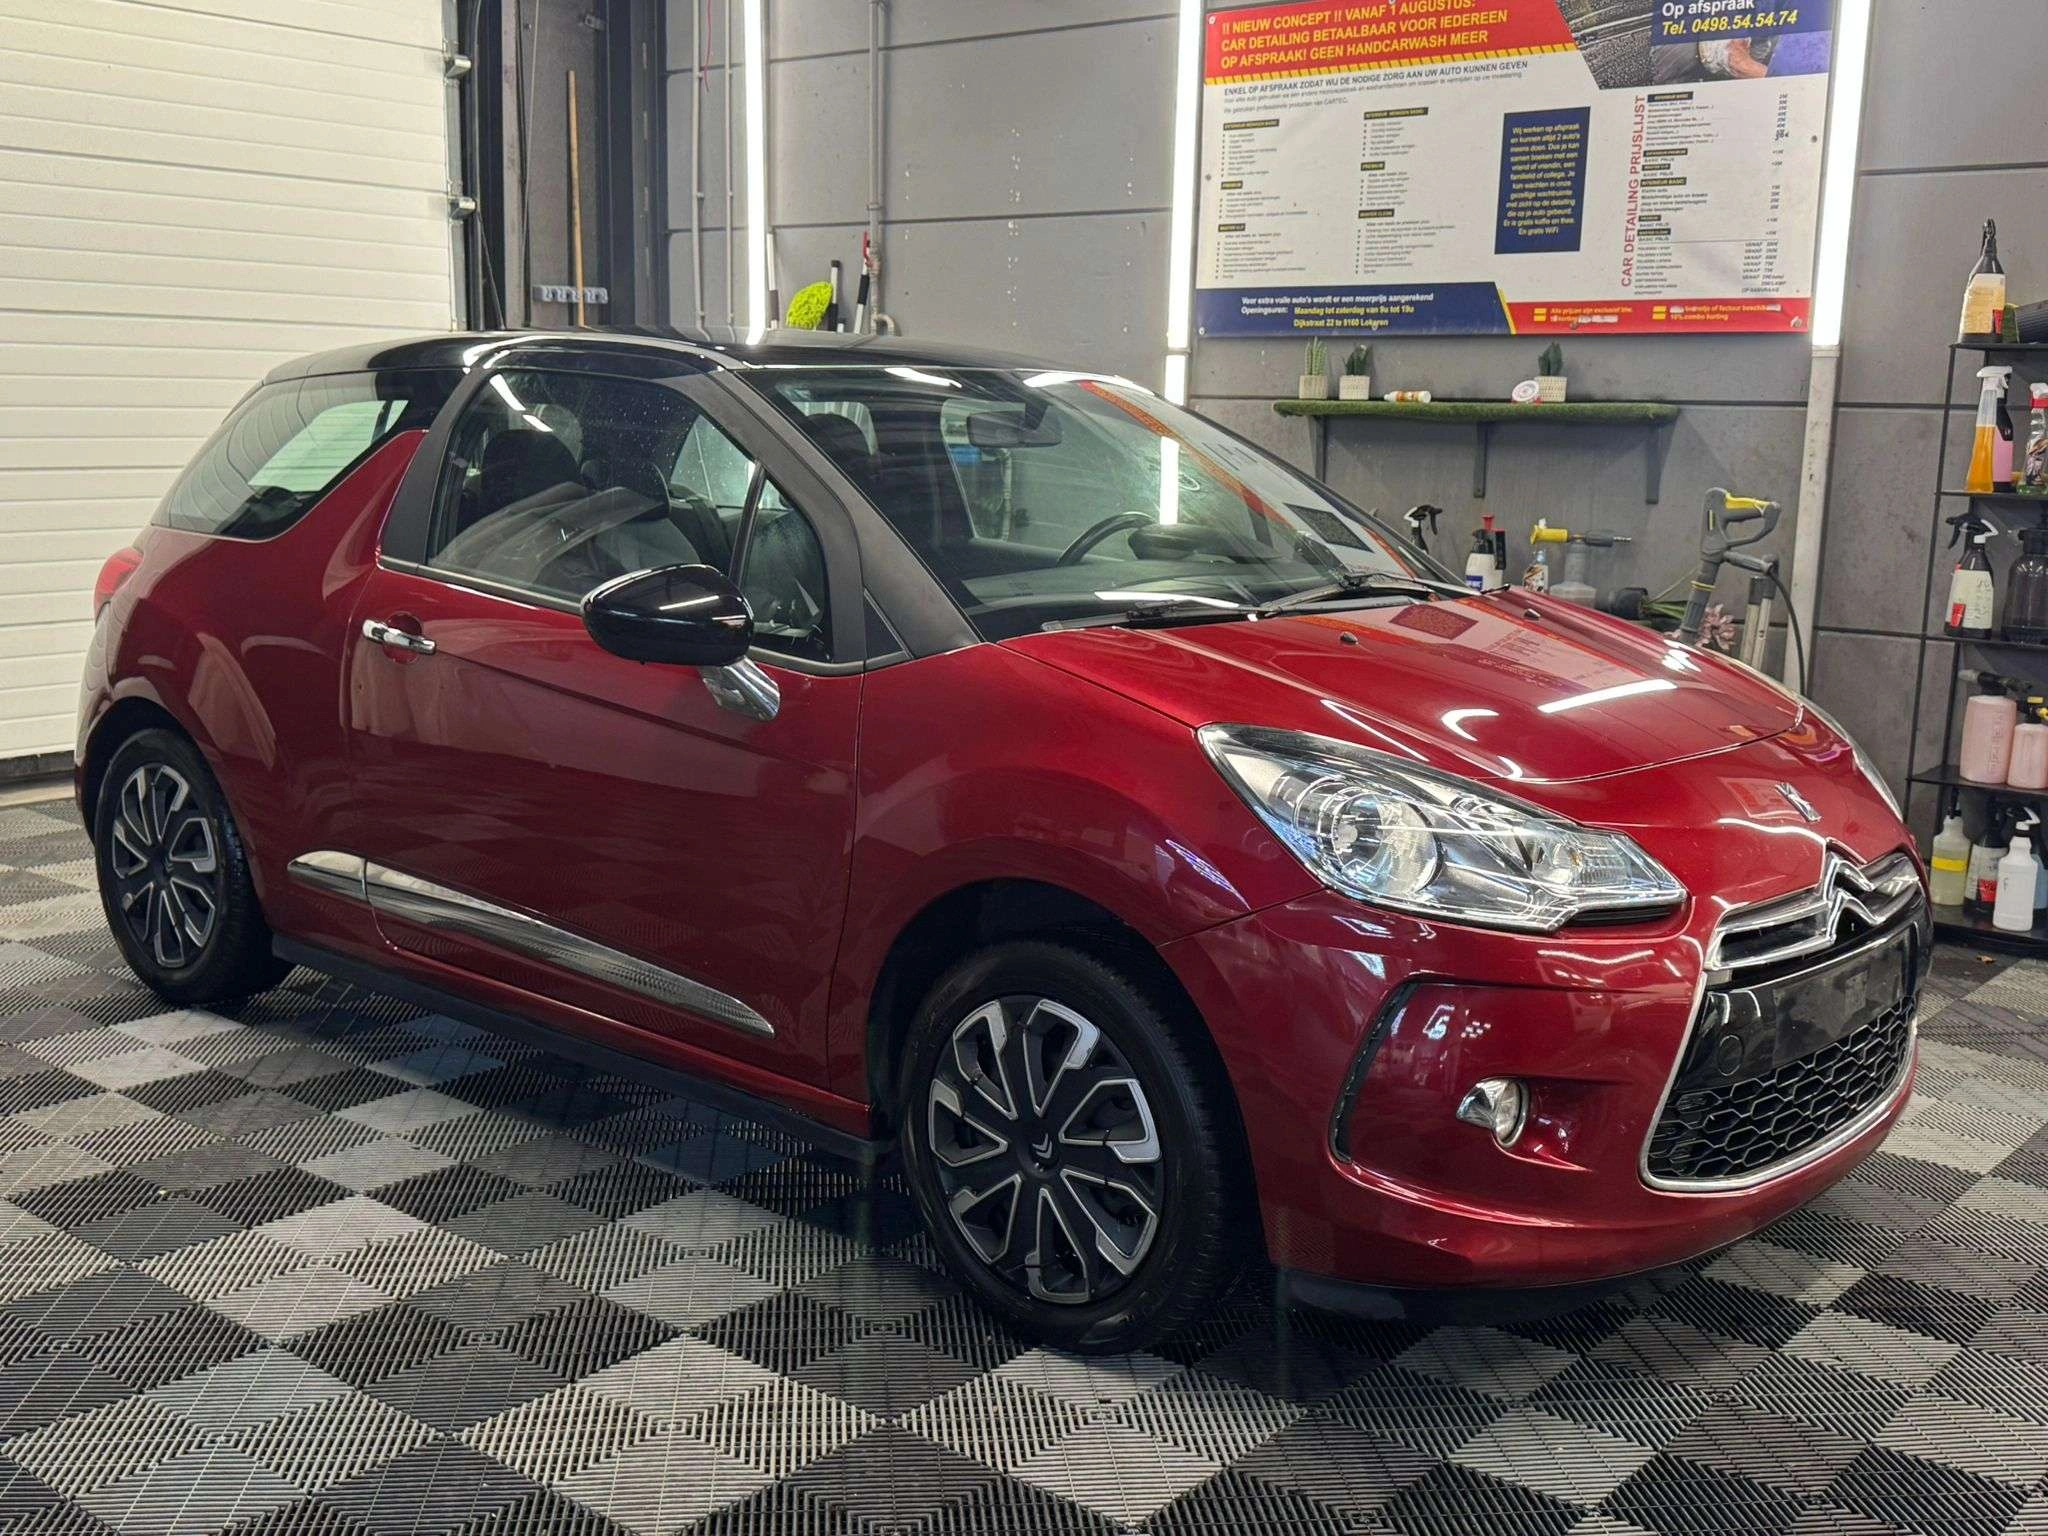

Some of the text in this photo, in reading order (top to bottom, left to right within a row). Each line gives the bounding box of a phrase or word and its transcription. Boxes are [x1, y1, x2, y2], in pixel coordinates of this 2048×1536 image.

[1232, 17, 1271, 34] NIEUW
[1273, 11, 1332, 29] CONCEPT
[1345, 4, 1387, 20] VANAF
[1662, 0, 1755, 18] Op afspraak
[1662, 9, 1798, 36] Tel. 0498.54.54.74
[1221, 9, 1508, 51] CAR DETAILING BETAALBAAR VOOR IEDEREEN
[1221, 30, 1489, 69] OP AFSPRAAK! GEEN HANDCARWASH MEER
[1224, 60, 1528, 96] ENKEL OP AFSPRAAK ZODAT WIJ DE NODIGE ZORG AAN UW AUTO KUNNEN GEVEN
[1554, 124, 1580, 132] afspraak
[1621, 95, 1646, 287] CAR DETAILING PRIJSLIJST
[1241, 306, 1288, 315] Openingsuren:
[1294, 307, 1325, 316] Maandag
[1335, 306, 1365, 315] zaterdag
[1291, 295, 1312, 303] auto's
[1313, 295, 1332, 303] wordt
[1355, 294, 1387, 303] meerprijs
[1388, 293, 1433, 303] aangerekend
[1293, 319, 1325, 328] Dijkstraat
